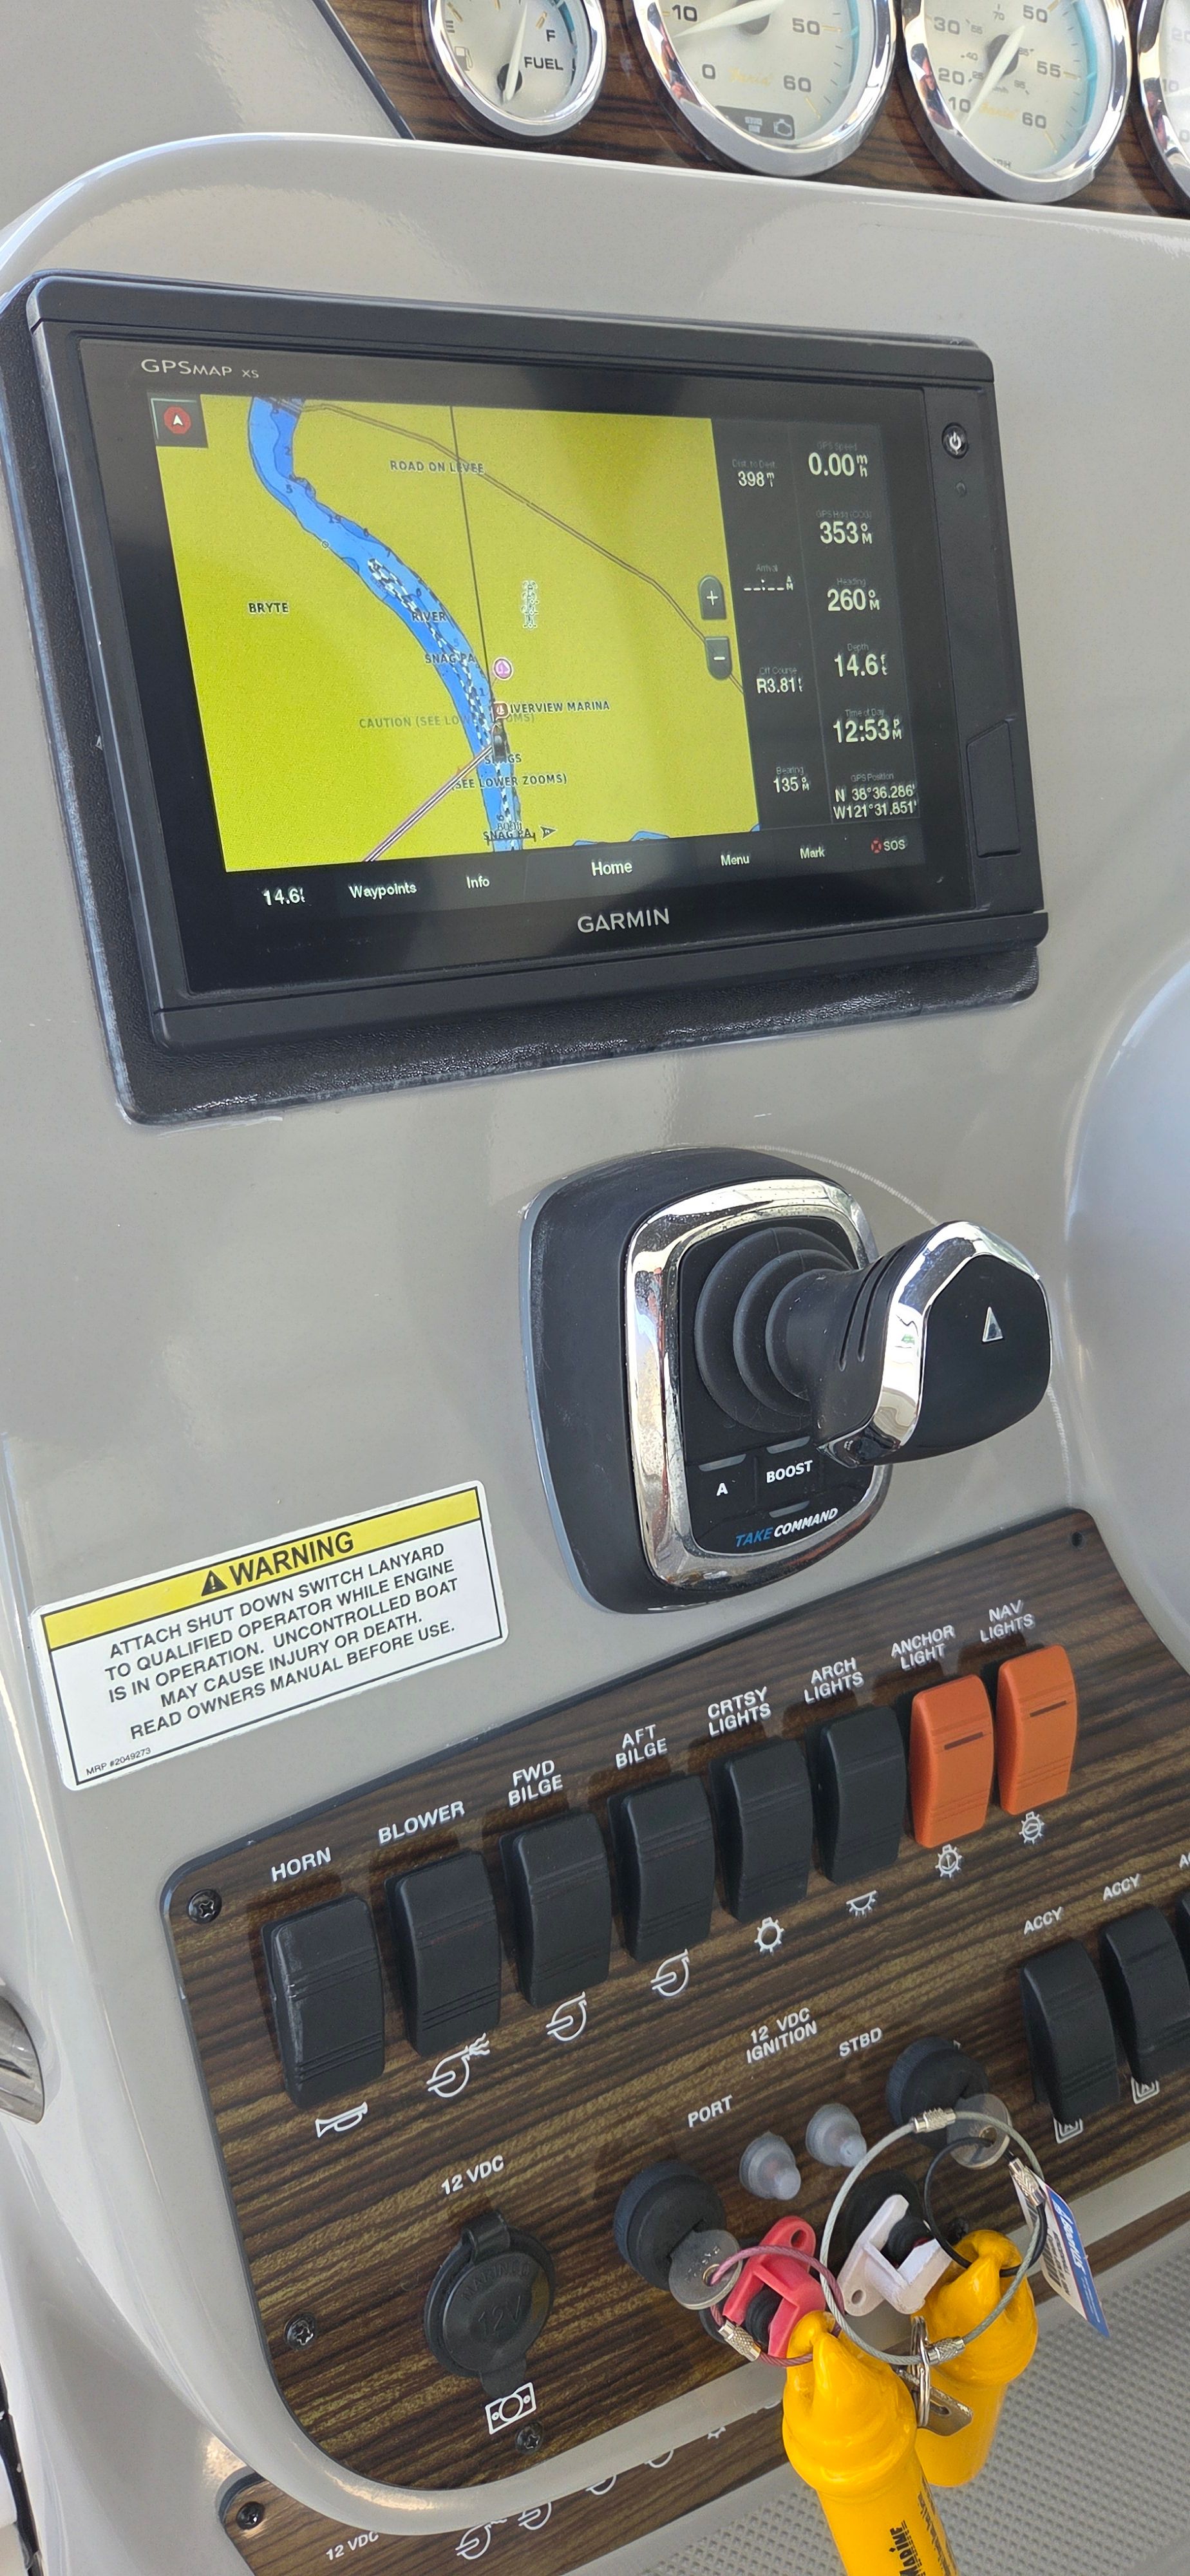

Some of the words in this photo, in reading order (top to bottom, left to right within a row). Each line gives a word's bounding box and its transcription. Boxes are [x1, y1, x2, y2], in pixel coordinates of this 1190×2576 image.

[672, 5, 697, 22] 10
[1023, 5, 1048, 23] 50
[546, 29, 556, 42] F
[792, 18, 820, 35] 50
[934, 17, 960, 35] 30
[524, 56, 563, 71] FUEL
[702, 64, 716, 79] 0
[1037, 61, 1061, 78] 55
[784, 75, 811, 93] 60
[938, 67, 965, 85] 20
[948, 97, 970, 113] 10
[1022, 111, 1046, 129] 60
[141, 359, 232, 376] GPSMAP
[390, 460, 424, 471] ROAD
[429, 462, 446, 472] ON
[450, 462, 485, 474] LEVEE
[808, 452, 855, 476] 0.00
[738, 471, 765, 487] 398
[820, 521, 859, 544] 353
[756, 564, 778, 573] Arrival
[836, 578, 867, 588] Heading
[248, 602, 289, 614] BRYTE
[827, 589, 866, 611] 260
[412, 612, 446, 621] RIVER
[847, 643, 869, 653] Depth
[425, 654, 456, 664] SNAG
[835, 653, 878, 677] 14.6
[773, 667, 797, 675] Course
[757, 677, 796, 694] R3.81
[567, 701, 610, 712] MARINA
[871, 708, 885, 718] Day
[359, 717, 411, 728] CAUTION
[416, 715, 441, 727] (SEE
[833, 719, 890, 743] 12:53
[480, 777, 518, 787] LOWER
[523, 773, 567, 786] ZOOMS)
[776, 766, 804, 776] Bearing
[851, 774, 866, 782] GPS
[867, 773, 894, 781] Position
[773, 777, 798, 793] 135
[835, 788, 845, 802] N
[800, 847, 825, 859] Mark
[883, 840, 905, 851] SOS
[592, 861, 633, 876] Home
[721, 854, 750, 866] Menu
[348, 881, 417, 900] Waypoints
[466, 875, 490, 889] Info
[263, 887, 298, 906] 14.6
[578, 908, 670, 934] GARMIN
[766, 1460, 813, 1483] BOOST
[716, 1482, 728, 1496] A
[735, 1527, 773, 1548] TAKE
[774, 1508, 838, 1537] COMMAND
[229, 1531, 354, 1586] WARNING
[110, 1624, 182, 1659] ATTACH
[187, 1606, 234, 1633] SHUT
[240, 1589, 294, 1618] DOWN
[299, 1566, 364, 1598] SWITCH
[368, 1542, 444, 1577] LANYARD
[105, 1662, 131, 1680] TO
[137, 1629, 232, 1671] QUALIFIED
[238, 1598, 332, 1638] OPERATOR
[337, 1580, 390, 1607] WHILE
[395, 1559, 455, 1588] ENGINE
[988, 1599, 1023, 1622] NAV
[979, 1613, 1034, 1642] LIGHTS
[108, 1685, 128, 1703] IS
[131, 1678, 150, 1696] IN
[155, 1642, 265, 1687] OPERATION.
[273, 1594, 410, 1649] UNCONTROLLED
[415, 1578, 458, 1603] BOAT
[891, 1625, 954, 1658] ANCHOR
[160, 1683, 199, 1707] MAY
[203, 1662, 265, 1692] CAUSE
[269, 1640, 329, 1671] INJURY
[334, 1631, 359, 1649] OR
[364, 1613, 422, 1640] DEATH.
[900, 1643, 945, 1671] LIGHT
[130, 1711, 182, 1739] READ
[187, 1682, 266, 1719] OWNERS
[270, 1658, 343, 1692] MANUAL
[347, 1633, 414, 1665] BEFORE
[418, 1620, 455, 1641] USE.
[810, 1657, 857, 1685] ARCH
[804, 1671, 864, 1704] LIGHTS
[708, 1686, 768, 1720] CRTSY
[708, 1703, 771, 1737] LIGHTS
[621, 1724, 656, 1749] AFT
[86, 1762, 108, 1776] MRP
[109, 1747, 152, 1767] #2049273
[616, 1738, 668, 1770] BILGE
[512, 1759, 555, 1788] FWD
[508, 1774, 563, 1807] BILGE
[378, 1800, 466, 1846] BLOWER
[271, 1846, 332, 1882] HORN
[1102, 1873, 1141, 1901] ACCY
[1023, 1906, 1064, 1935] ACCY
[750, 2028, 770, 2044] 12
[777, 2007, 811, 2032] VDC
[746, 2022, 818, 2063] IGNITION
[838, 2028, 883, 2058] STBD
[688, 2095, 733, 2128] PORT
[441, 2174, 463, 2195] 12
[467, 2154, 505, 2184] VDC
[326, 2544, 345, 2561] 12
[348, 2531, 379, 2551] VDC
